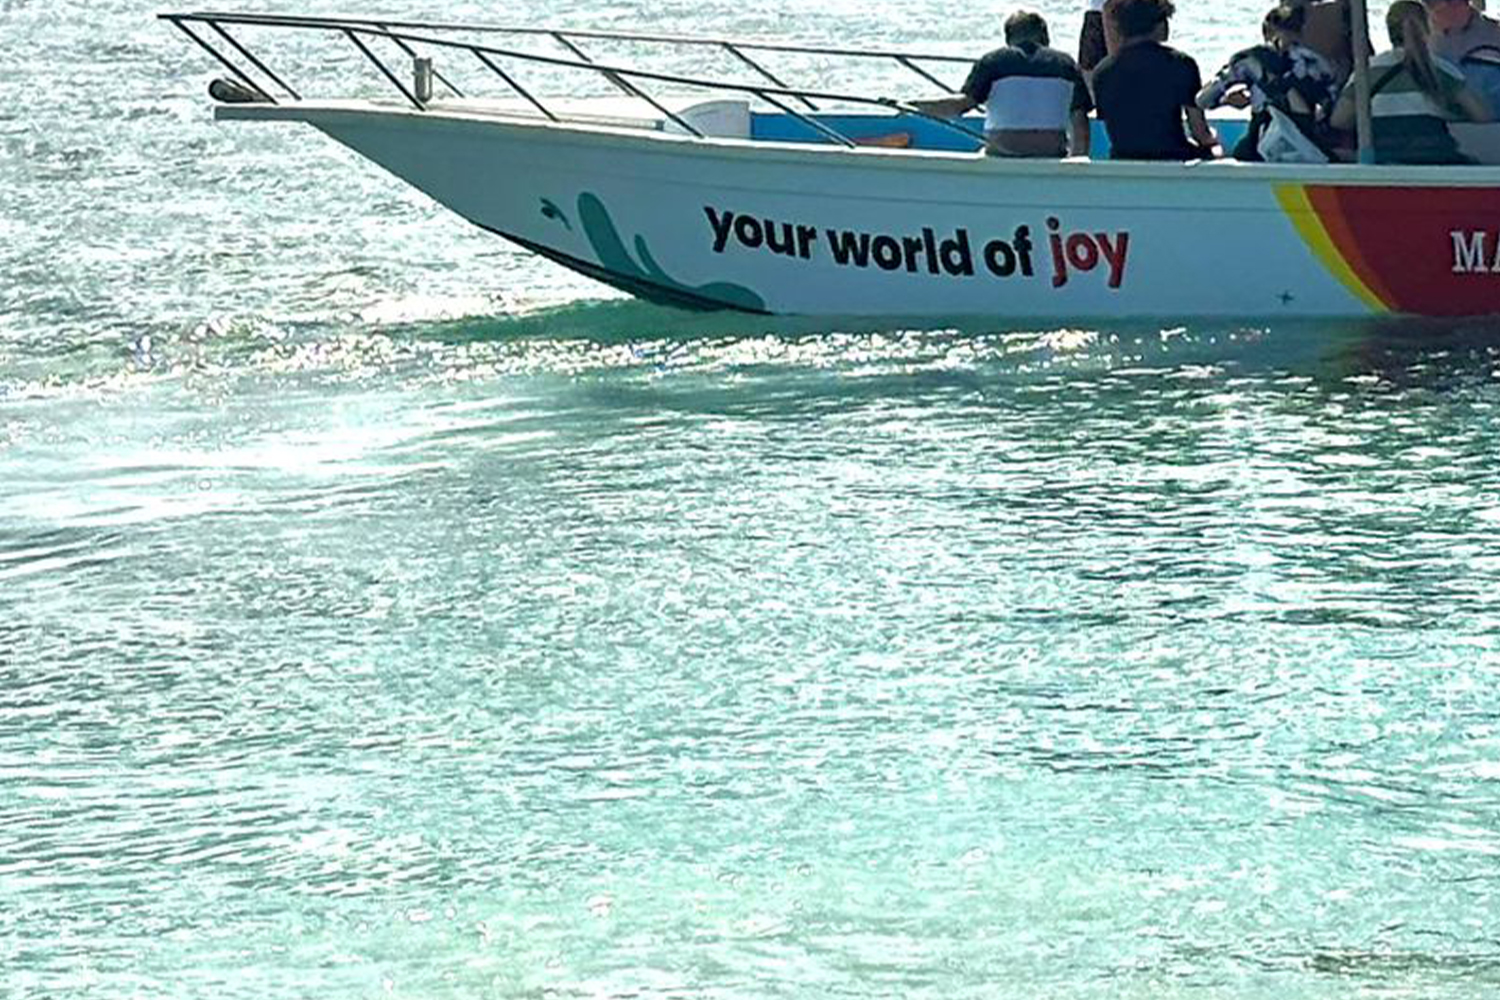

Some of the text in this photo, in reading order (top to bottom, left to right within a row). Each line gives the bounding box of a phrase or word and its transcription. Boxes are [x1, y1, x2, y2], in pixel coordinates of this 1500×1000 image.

[703, 206, 1129, 289] your world of joy
